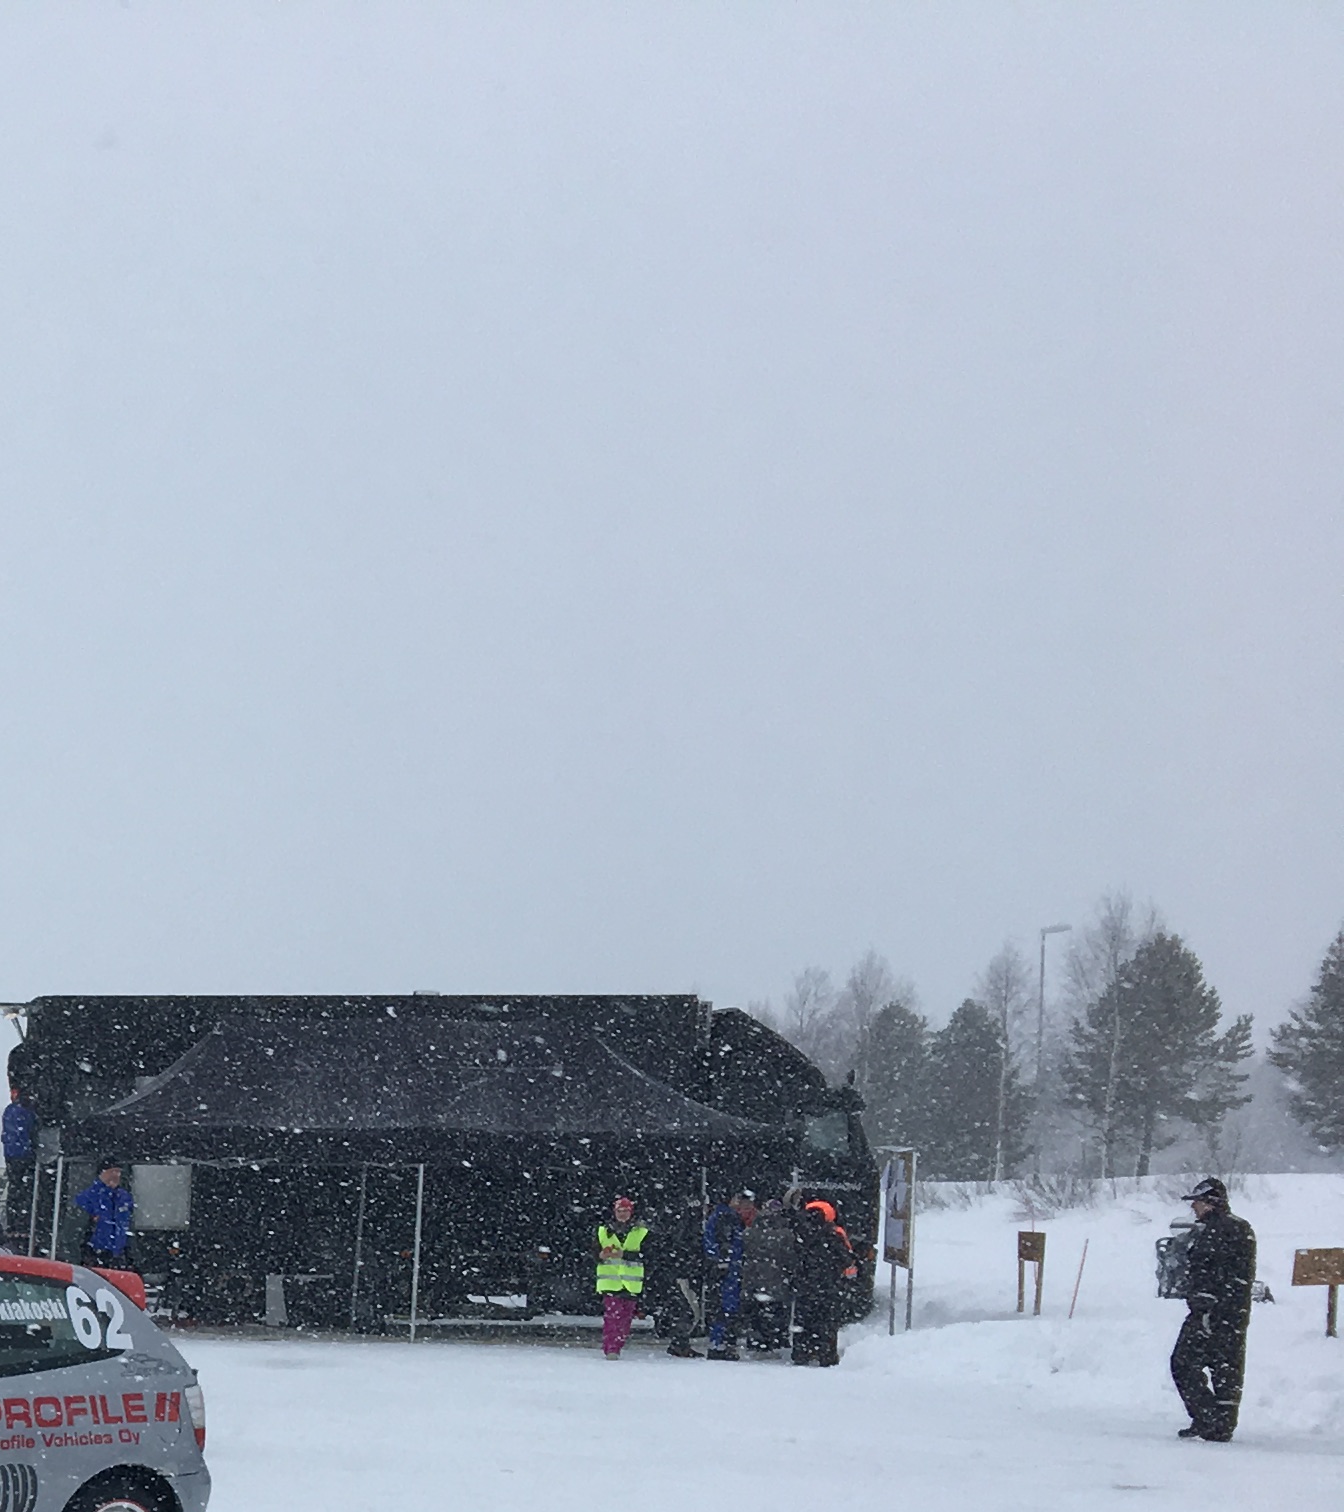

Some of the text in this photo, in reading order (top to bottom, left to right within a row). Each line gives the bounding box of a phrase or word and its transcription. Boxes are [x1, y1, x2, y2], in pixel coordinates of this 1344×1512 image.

[65, 1285, 134, 1350] 62
[41, 1431, 113, 1448] Vehicles
[118, 1428, 140, 1445] Oy
